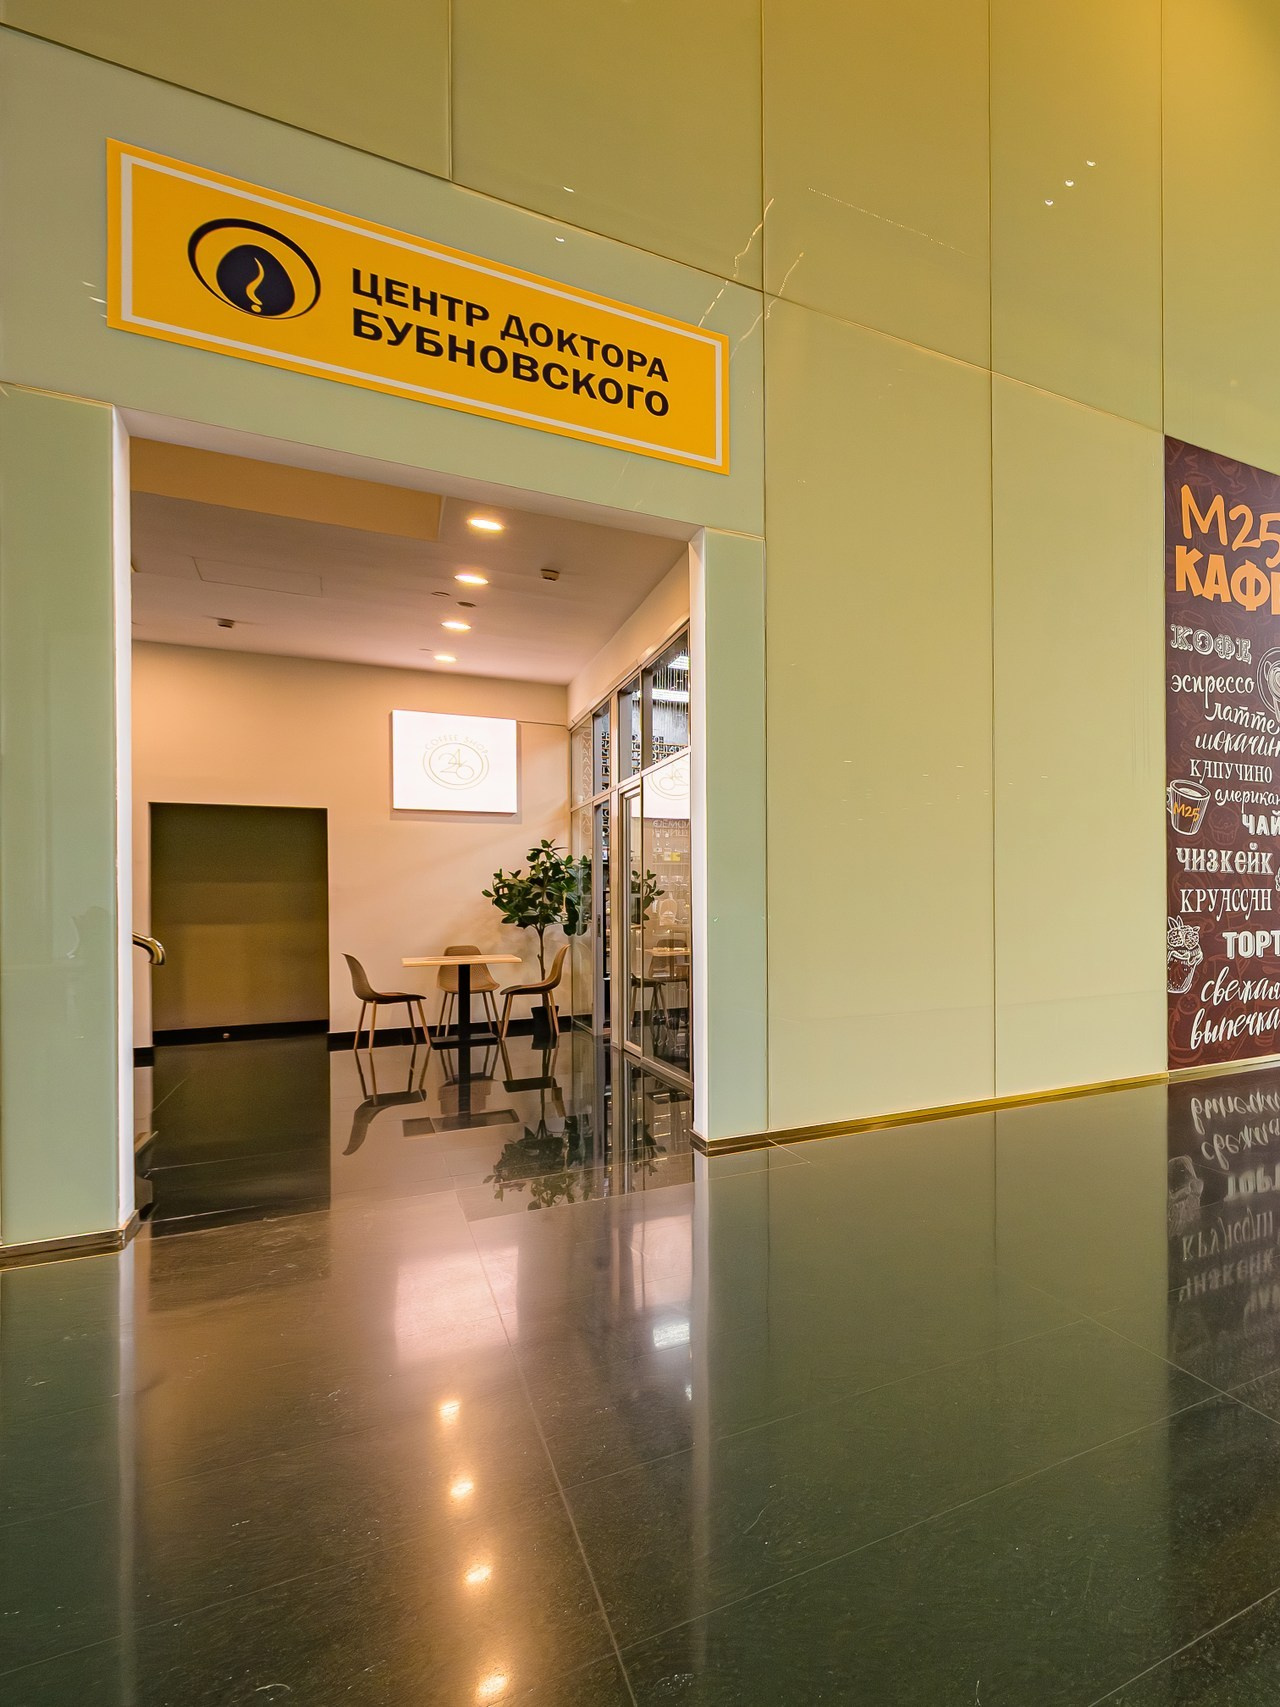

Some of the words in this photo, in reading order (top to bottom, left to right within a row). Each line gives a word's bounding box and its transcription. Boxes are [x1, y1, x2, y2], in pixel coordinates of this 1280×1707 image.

[352, 267, 490, 328] ЦЕНТР
[500, 314, 669, 382] ДОКТОРА
[352, 307, 670, 417] БУБНОВСКОГО
[1170, 624, 1252, 664] КОФЕ
[1171, 674, 1254, 708] эспрессо
[1205, 702, 1280, 735] латте
[1190, 759, 1272, 783] КАПУЧИНО
[1180, 888, 1272, 921] КРУАССАН
